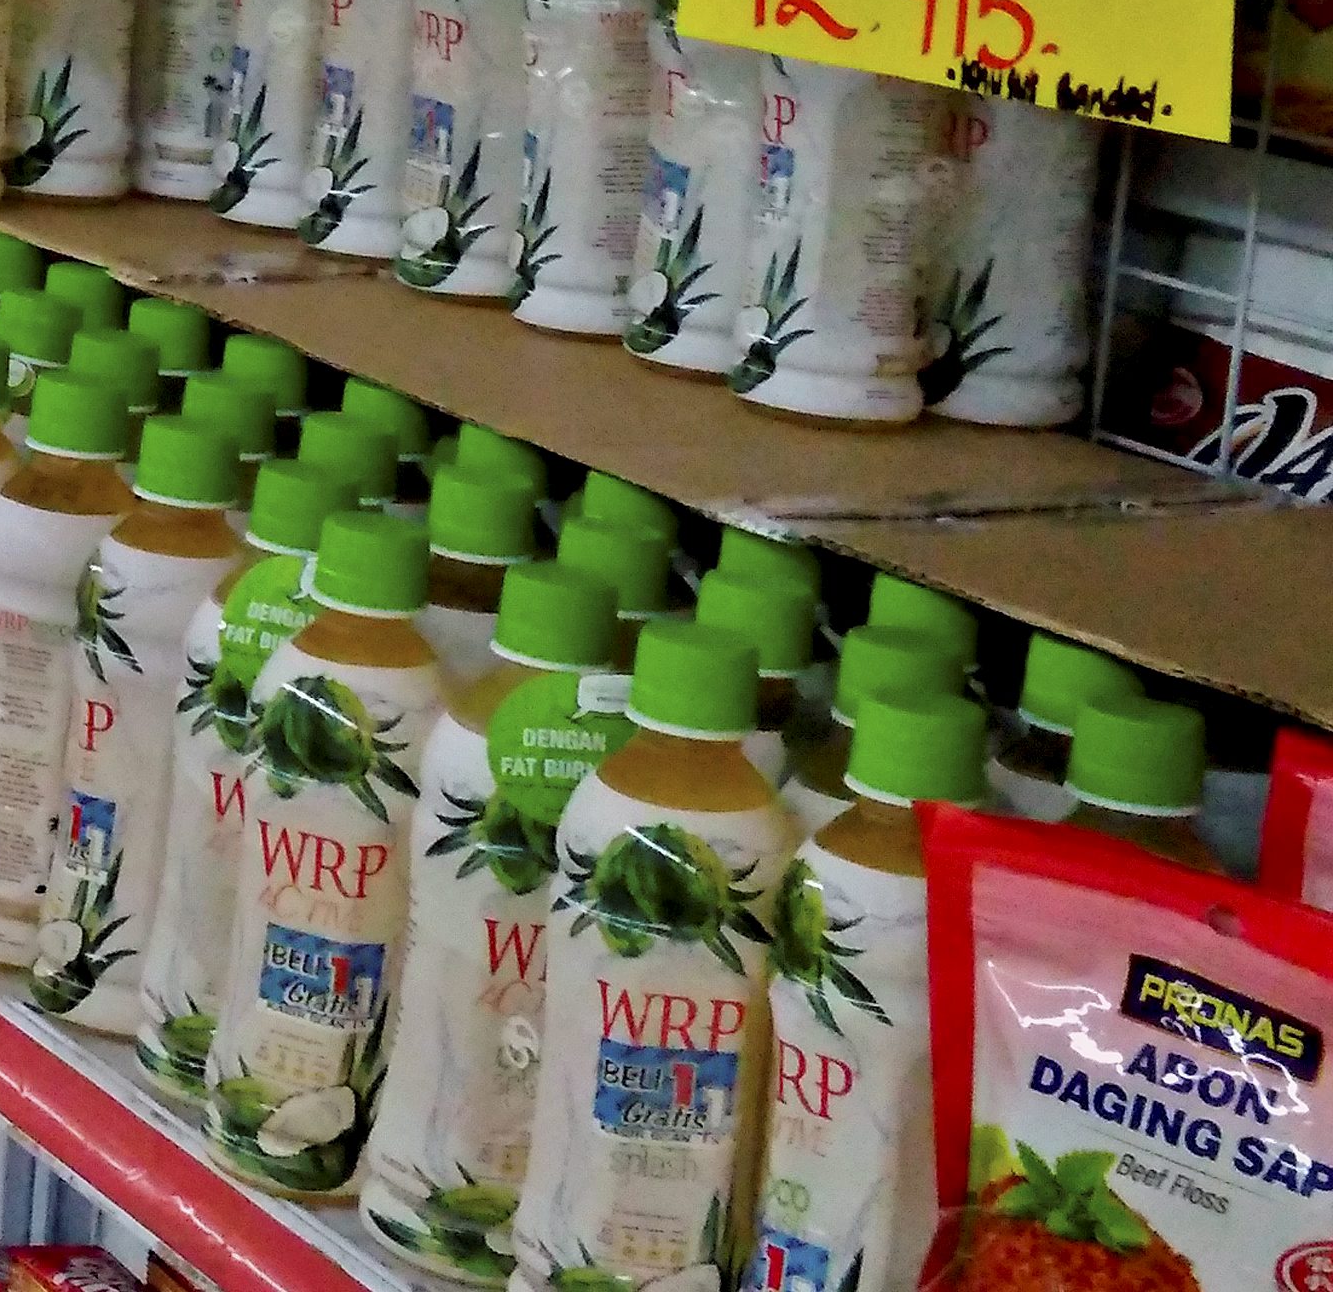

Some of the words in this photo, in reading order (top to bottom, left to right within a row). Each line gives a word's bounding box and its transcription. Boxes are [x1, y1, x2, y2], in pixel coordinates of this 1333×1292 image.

[419, 10, 465, 62] RP
[501, 756, 537, 777] FAT
[544, 758, 595, 780] BUR
[523, 728, 606, 752] DENGAN
[257, 818, 389, 900] WRP
[597, 979, 744, 1053] WRP
[1138, 972, 1306, 1062] PRONAS
[603, 1058, 661, 1090] BELI
[671, 1062, 696, 1108] 1
[621, 1097, 707, 1130] Gratis
[777, 1038, 853, 1121] RP
[1030, 1054, 1223, 1162] DAGING
[1124, 1042, 1277, 1127] ABON
[1115, 1152, 1171, 1191] Beef
[1174, 1173, 1231, 1216] Floss
